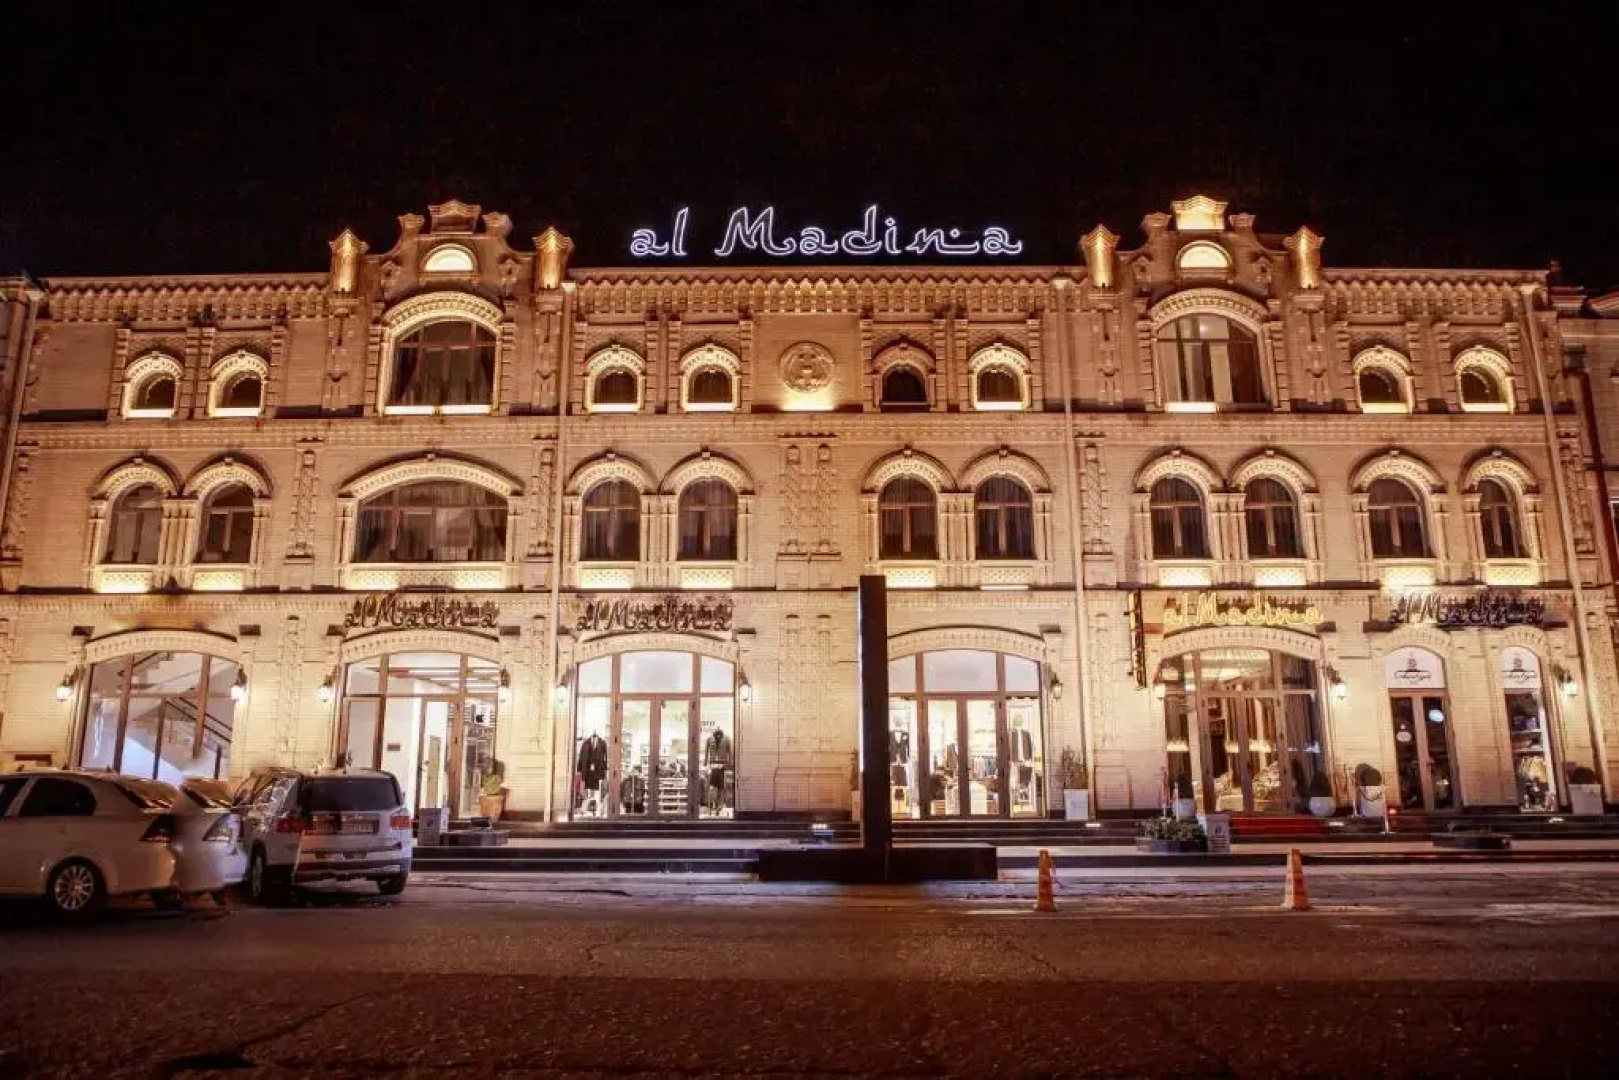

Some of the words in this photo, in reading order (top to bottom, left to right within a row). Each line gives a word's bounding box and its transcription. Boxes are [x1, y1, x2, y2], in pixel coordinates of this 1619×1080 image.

[630, 206, 688, 256] al
[714, 204, 1023, 256] Madina
[1194, 592, 1324, 626] Madina
